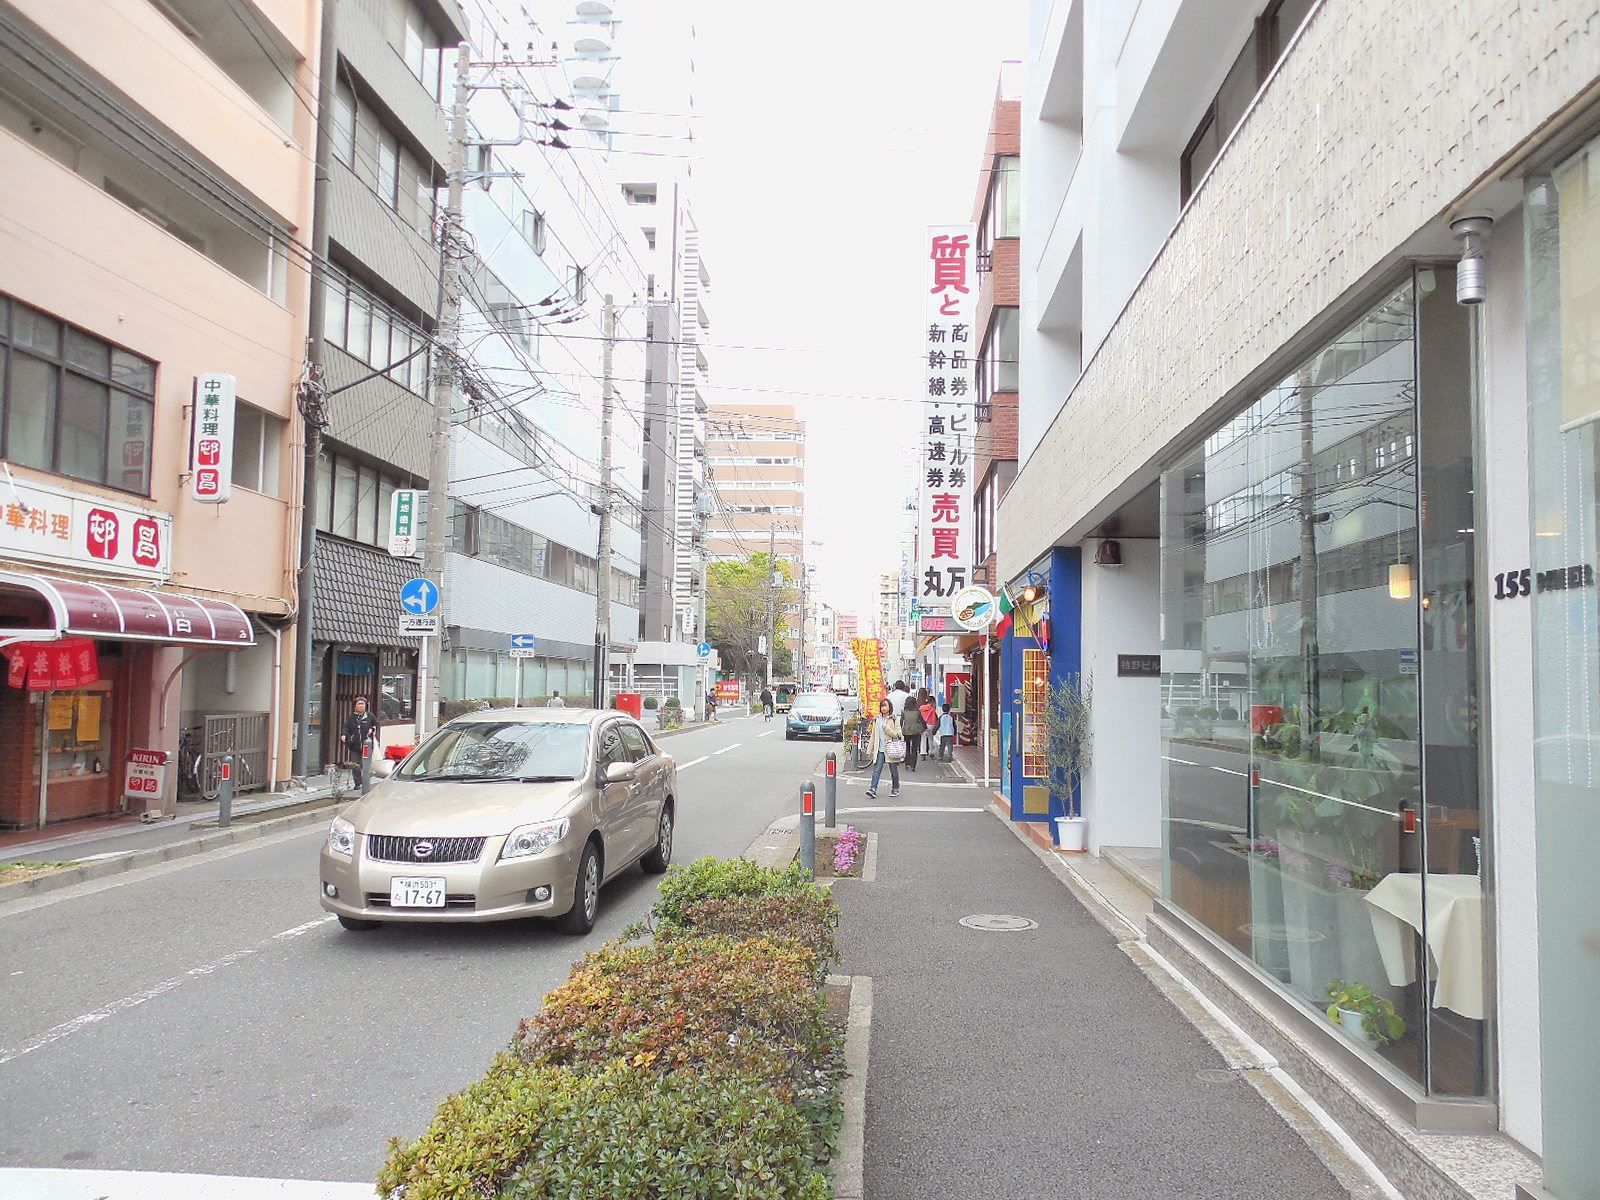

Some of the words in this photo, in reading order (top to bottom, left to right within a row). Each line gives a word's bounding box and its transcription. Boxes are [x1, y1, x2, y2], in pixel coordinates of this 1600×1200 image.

[930, 234, 970, 316] 質と
[202, 379, 221, 436] 中華料理
[926, 323, 947, 488] 新幹線・高速券
[0, 502, 71, 541] 華料理
[931, 492, 961, 559] 売買
[1494, 568, 1531, 600] 155
[132, 753, 160, 764] KIRIN
[405, 890, 442, 904] 17-67
